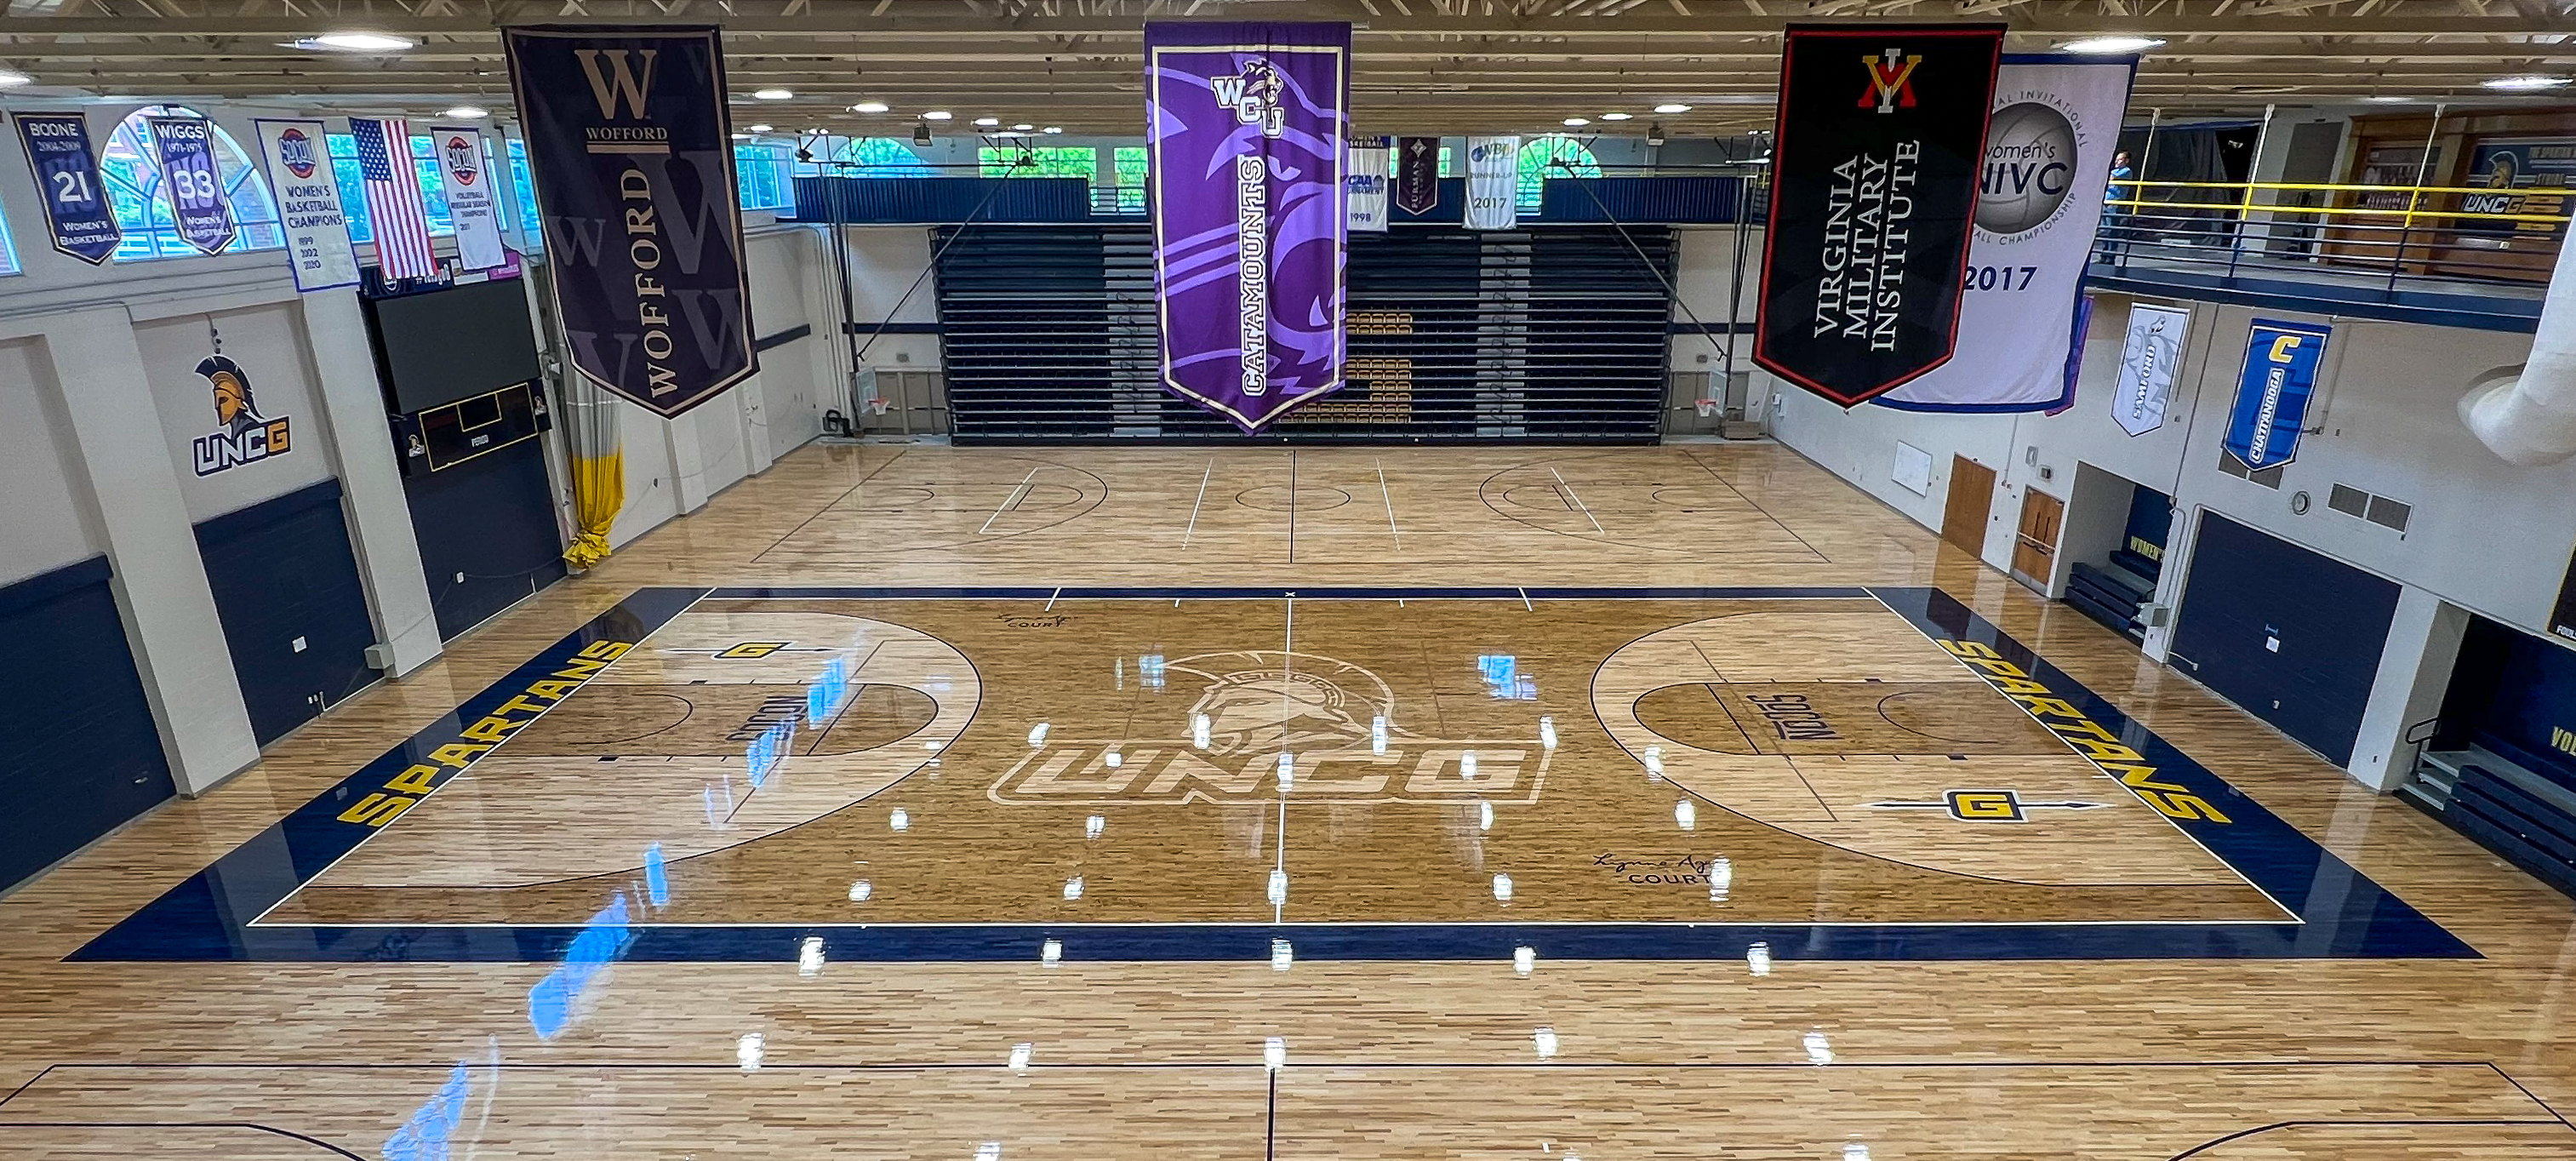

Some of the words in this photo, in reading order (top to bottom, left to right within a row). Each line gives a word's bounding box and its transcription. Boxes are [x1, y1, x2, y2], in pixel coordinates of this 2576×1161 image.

[574, 49, 658, 120] W
[1210, 76, 1285, 139] WCU
[2019, 89, 2088, 148] INVITATIONAL
[28, 122, 79, 137] BOONE
[154, 124, 206, 140] WIGGS
[585, 126, 668, 141] WOFFORD
[52, 170, 93, 203] 21
[173, 169, 215, 200] 33
[285, 185, 331, 197] WOMEN'S
[1474, 197, 1507, 209] 2017
[285, 200, 339, 214] BASKETBALL
[288, 214, 343, 229] CHAMPIONS
[1999, 192, 2076, 246] CHAMPIONSHIP
[2462, 195, 2527, 214] UNCG
[62, 220, 109, 232] WOMEN'S
[1871, 139, 1922, 352] INSTITUTE
[1814, 157, 1859, 339] VIRGINIA
[1843, 152, 1888, 340] MILITARY
[620, 169, 679, 398] WOFFORD
[1239, 155, 1267, 397] CATAMOUNTS
[1965, 266, 2037, 292] 2017
[2268, 335, 2302, 364] C
[2249, 368, 2284, 463] CHATTANOOGA
[195, 420, 290, 475] UNCG
[336, 639, 634, 827] SPARTANS
[1745, 694, 1846, 741] SOCON
[1935, 638, 2232, 824] SPARTANS
[1014, 749, 1528, 794] UNCG
[1950, 792, 2020, 820] G
[1628, 874, 1712, 884] COURT
